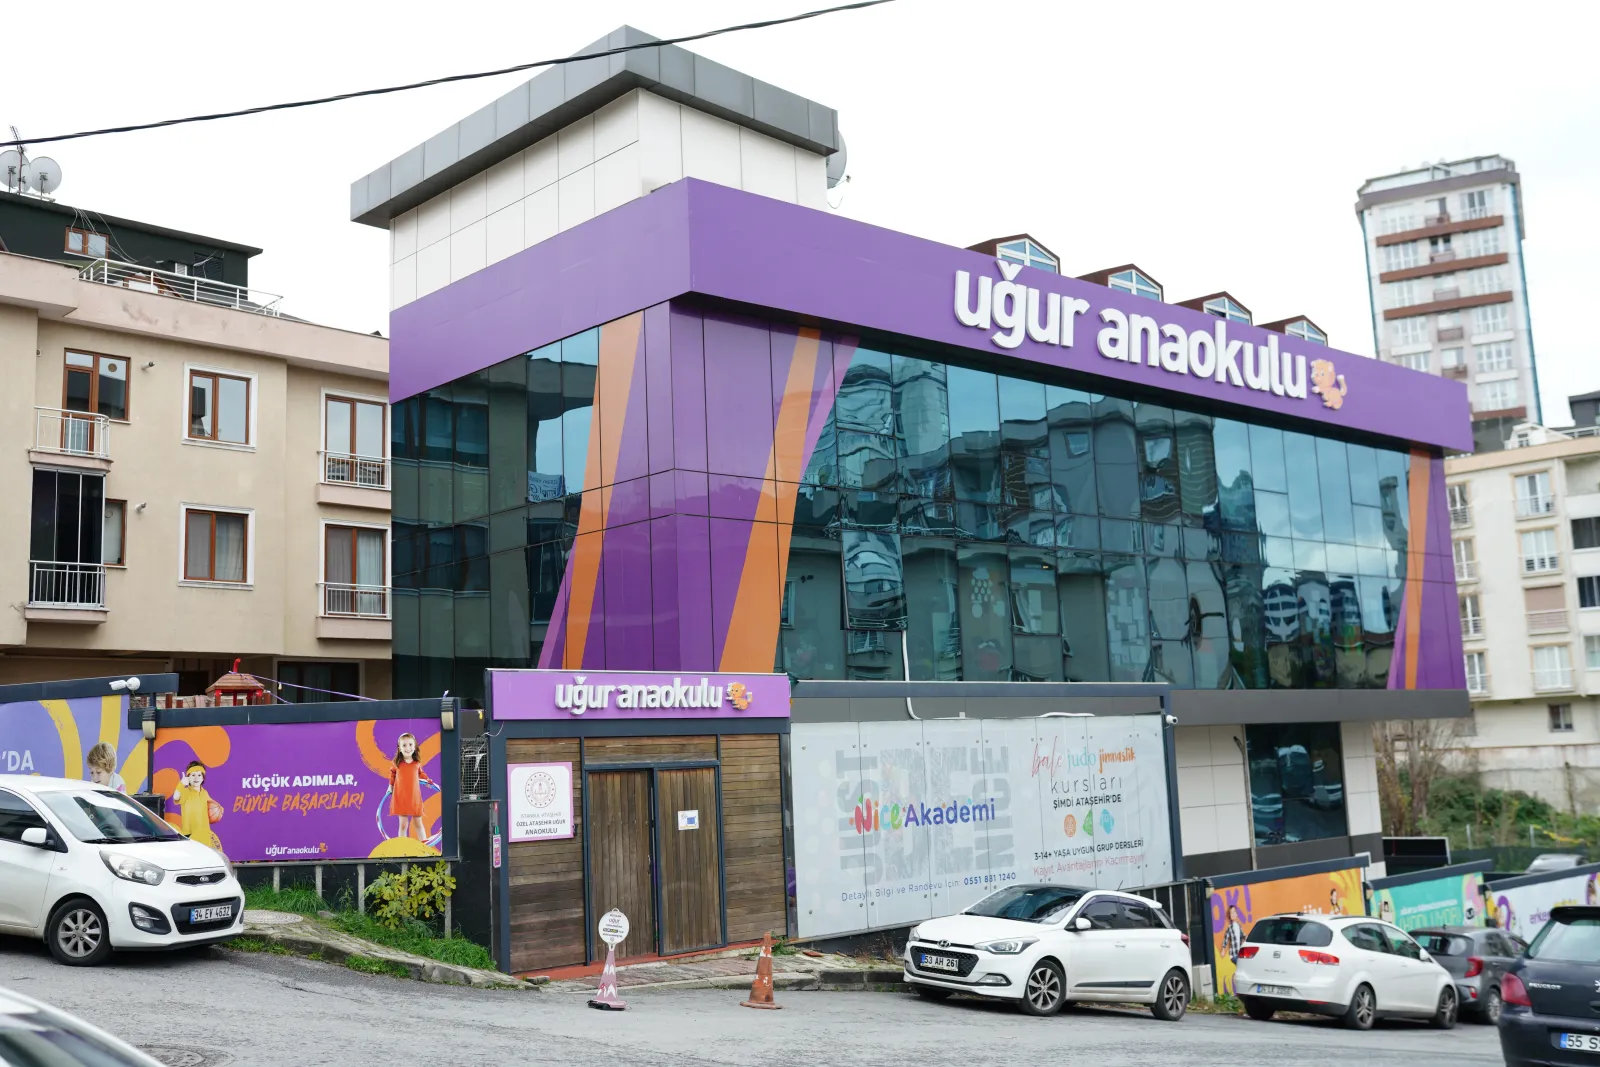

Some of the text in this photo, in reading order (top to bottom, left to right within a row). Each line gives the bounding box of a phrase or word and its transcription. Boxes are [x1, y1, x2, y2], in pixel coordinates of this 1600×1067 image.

[954, 259, 1307, 399] uğur anaokulu
[555, 676, 723, 715] uğur anaokulu
[1067, 746, 1096, 774] judo
[242, 774, 358, 791] KÜÇÜK ADIMLAR,
[1051, 774, 1122, 794] kursları
[233, 791, 365, 816] BÜYÜK BAŞARILAR!
[1053, 793, 1122, 809] ŞİMDİ ATAŞEHİR'DE
[904, 798, 995, 828] Akademi
[266, 844, 320, 856] uğur anaokulu
[1034, 838, 1144, 860] 3-14+ YAŞA UYGUN GRUP DERSLERİ
[908, 881, 942, 891] Randevu
[964, 877, 982, 886] 0551
[999, 871, 1016, 881] 1240
[194, 909, 202, 920] 34
[215, 906, 230, 917] 4632
[925, 955, 932, 964] 53
[934, 957, 943, 966] AH
[946, 958, 958, 968] 261
[1567, 1035, 1600, 1050] 55 S
